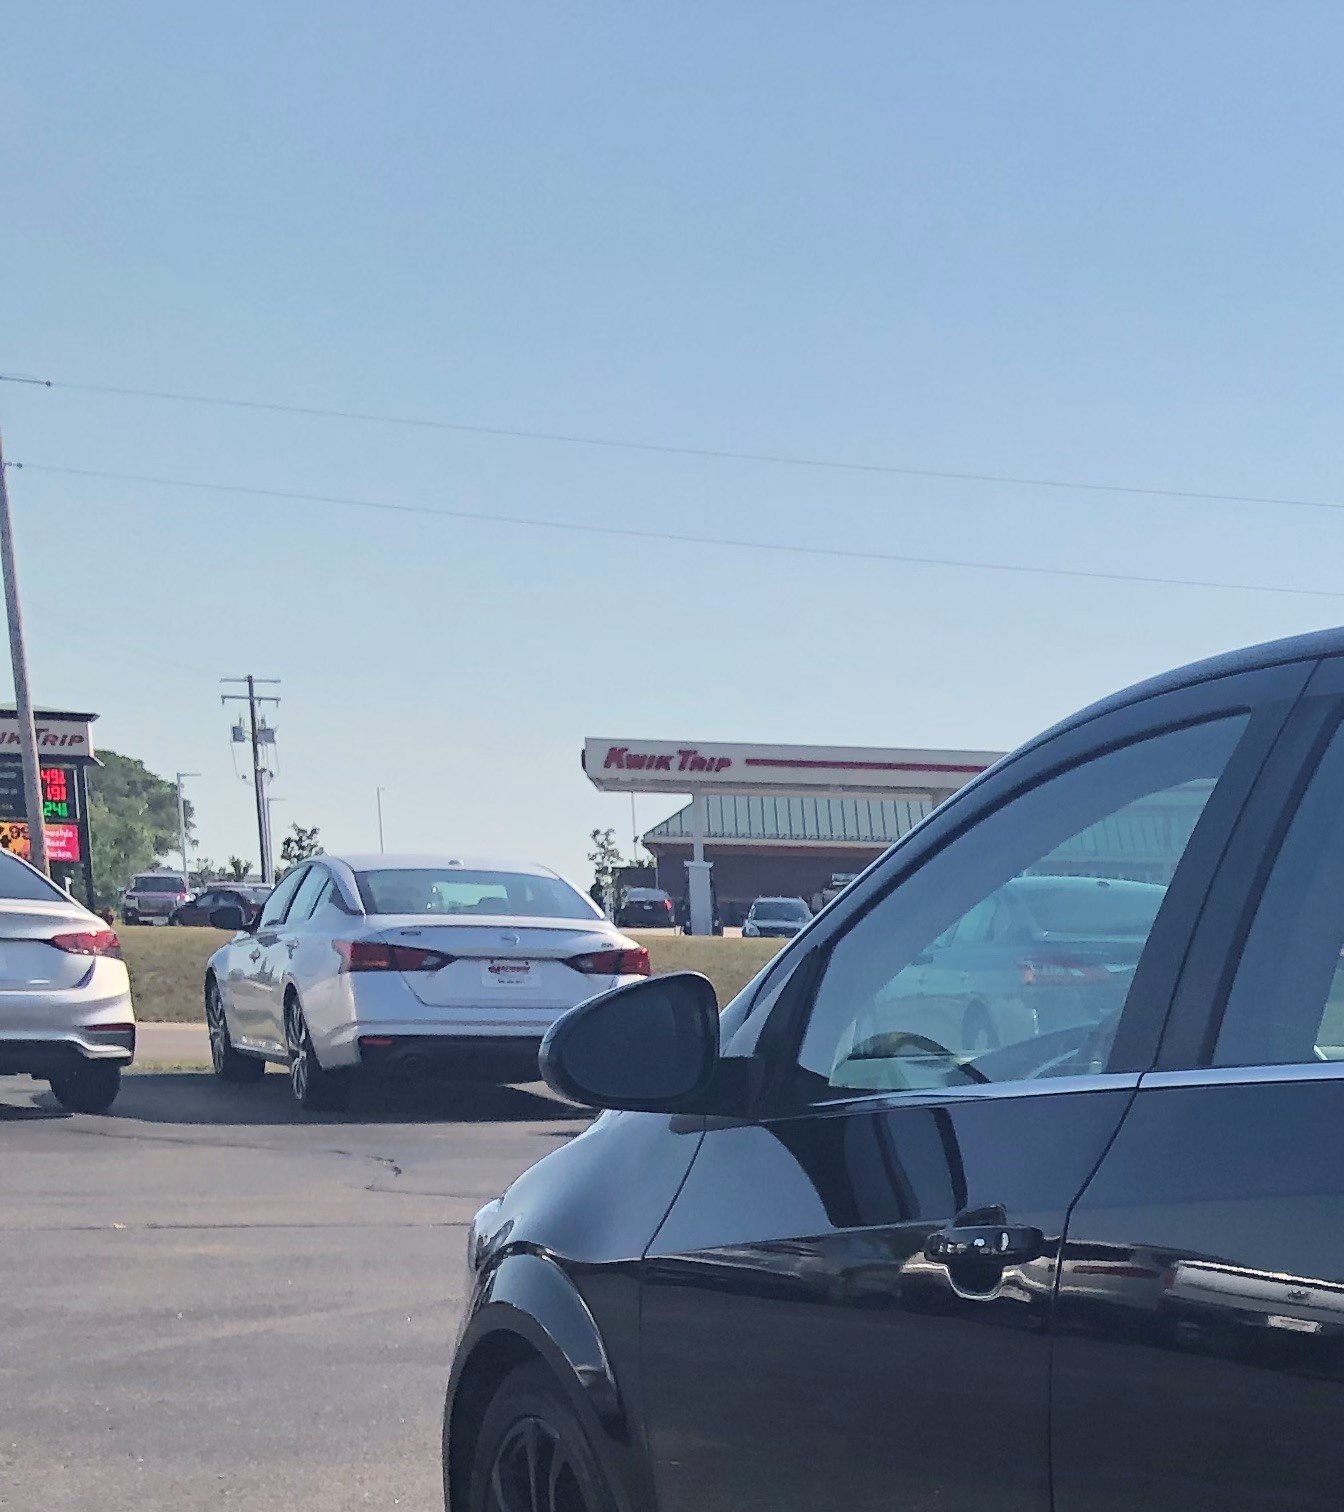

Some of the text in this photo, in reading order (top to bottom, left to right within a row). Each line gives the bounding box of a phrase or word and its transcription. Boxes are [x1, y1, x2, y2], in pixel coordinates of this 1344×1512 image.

[35, 727, 85, 747] TRIP
[603, 747, 732, 772] KWIK TRIP
